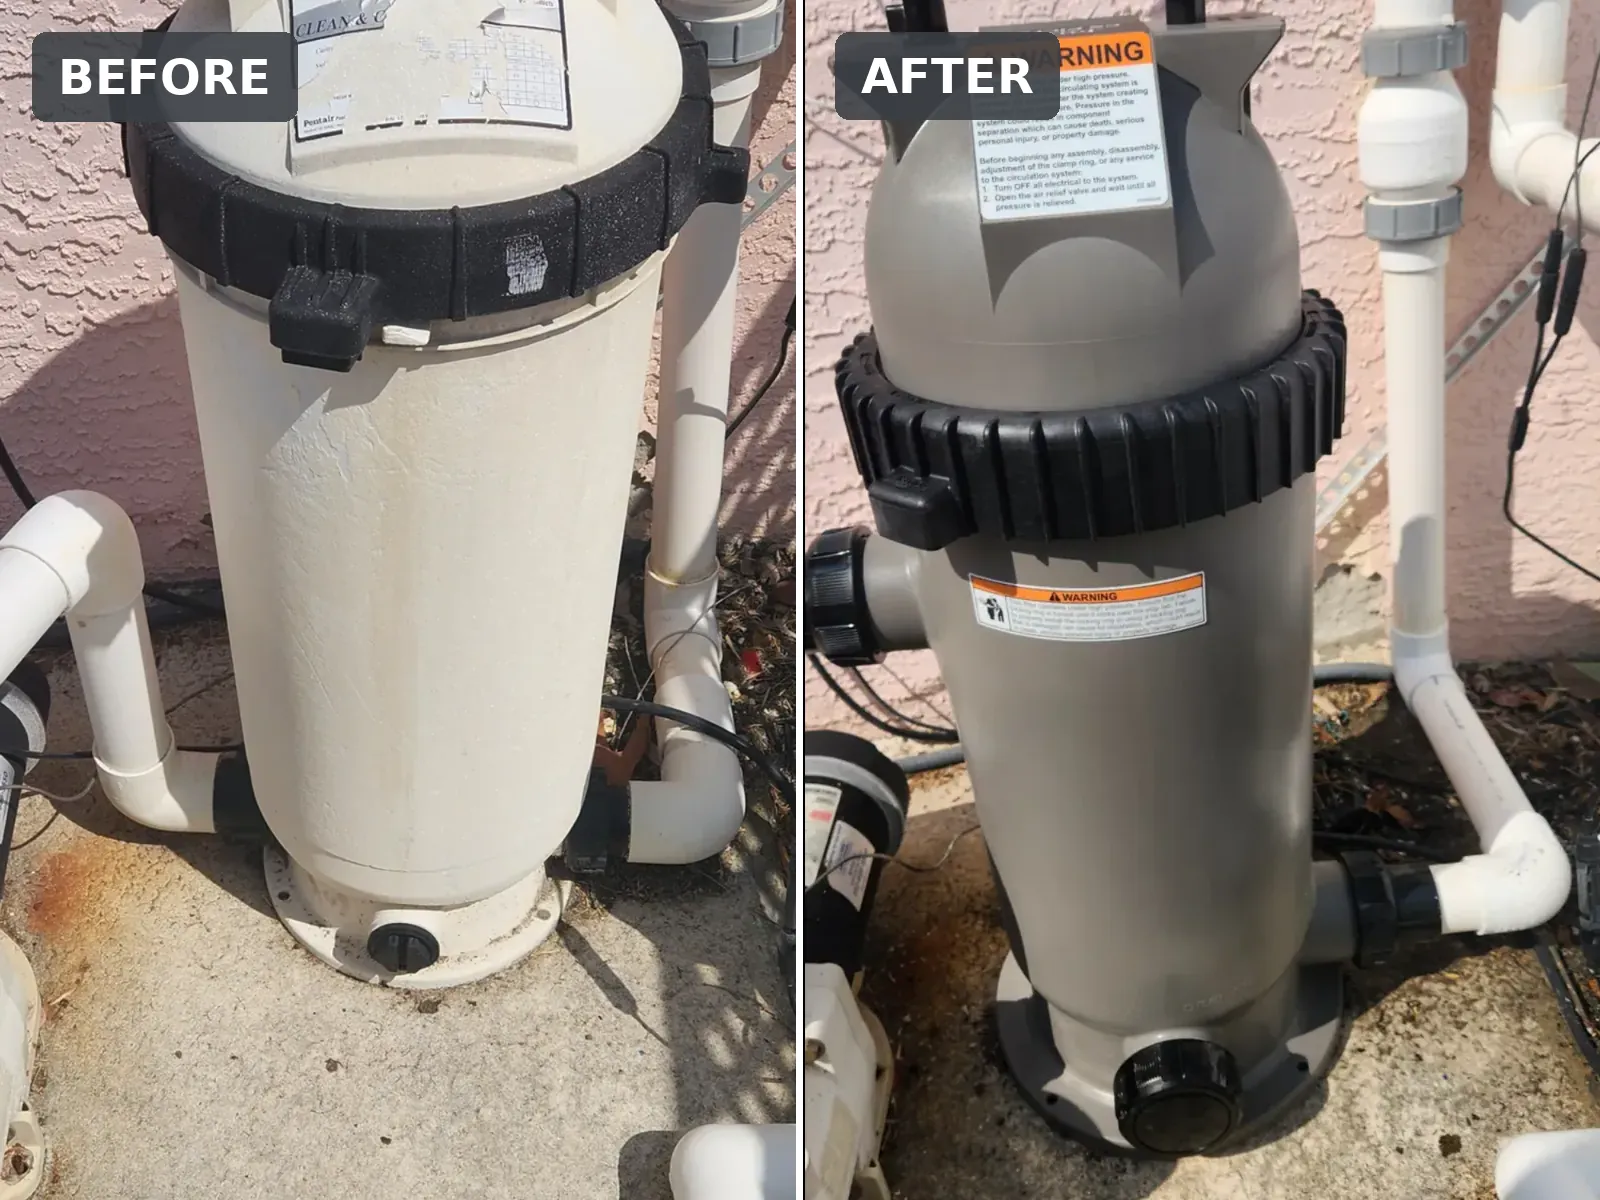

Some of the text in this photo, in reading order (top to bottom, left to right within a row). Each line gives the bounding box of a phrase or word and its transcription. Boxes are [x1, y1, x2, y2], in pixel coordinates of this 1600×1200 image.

[296, 15, 351, 37] CLEAN
[355, 12, 367, 26] &
[1073, 74, 1091, 83] high
[1093, 72, 1129, 81] pressure.
[1102, 81, 1129, 90] system
[1087, 91, 1115, 101] system
[1117, 88, 1148, 98] creating
[1076, 100, 1111, 109] Pressure
[304, 115, 334, 127] Pentair
[1065, 111, 1110, 121] component
[977, 127, 1019, 137] separation
[1022, 125, 1045, 133] which
[1064, 122, 1087, 130] cause
[1115, 116, 1145, 125] serious
[978, 137, 1013, 146] personal
[1052, 131, 1085, 140] property
[980, 156, 1006, 164] Before
[1008, 152, 1048, 163] beginning
[1050, 152, 1065, 160] any
[980, 164, 1026, 174] adjustment
[1052, 159, 1077, 170] clamp
[1110, 155, 1123, 164] any
[1126, 153, 1154, 162] service
[1007, 170, 1049, 182] circulation
[1044, 179, 1081, 188] electrical
[995, 194, 1017, 203] Open
[1019, 192, 1031, 200] the
[1046, 188, 1067, 197] relief
[1069, 187, 1089, 195] valve
[1092, 185, 1106, 193] and
[1127, 182, 1144, 190] until
[996, 202, 1032, 212] pressure
[1062, 592, 1118, 602] WARNING
